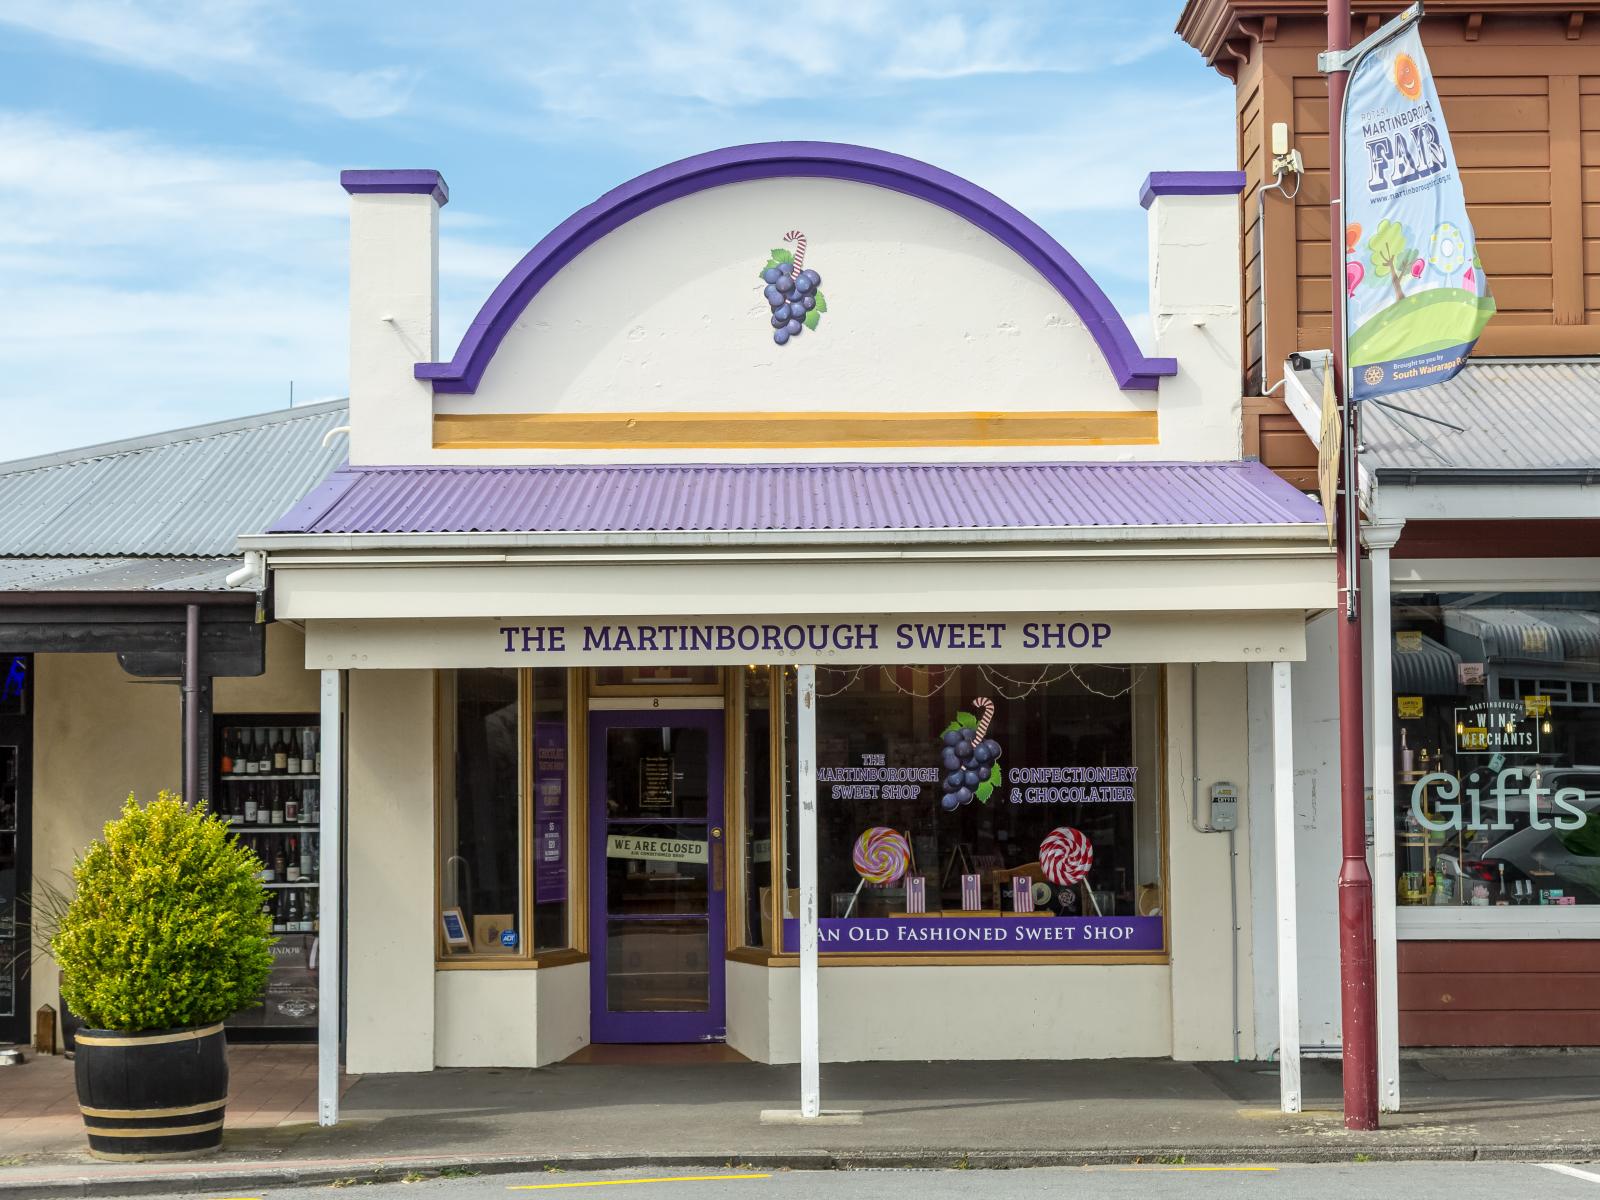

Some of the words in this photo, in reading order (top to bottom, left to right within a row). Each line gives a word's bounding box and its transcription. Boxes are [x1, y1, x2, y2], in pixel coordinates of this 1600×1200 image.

[1365, 121, 1448, 192] FAIR
[1393, 361, 1418, 369] Brought
[1393, 369, 1418, 380] South
[1420, 362, 1456, 374] Wairarapa
[500, 626, 565, 652] THE
[582, 624, 879, 651] MARTINBOROUGH
[896, 623, 1006, 649] SWEET
[1022, 622, 1112, 649] SHOP
[653, 698, 659, 708] 8
[1469, 701, 1523, 712] MARTINBOROUGH
[1477, 713, 1517, 728] WINE
[1462, 732, 1533, 746] MERCHANTS
[862, 754, 886, 766] THE
[816, 767, 939, 782] MARTINBOROUGH
[1008, 766, 1138, 783] CONFECTIONERY
[832, 785, 880, 800] SWEET
[881, 785, 921, 800] SHOP
[1010, 787, 1022, 803] &
[1024, 787, 1136, 803] CHOCOLATIER
[1411, 767, 1588, 831] Gifts
[615, 839, 631, 849] WE
[635, 841, 656, 851] ARE
[660, 842, 701, 854] CLOSED
[849, 926, 889, 941] OLD
[897, 926, 1008, 941] FASHIONED
[1015, 925, 1076, 941] SWEET
[1083, 925, 1134, 940] SHOP
